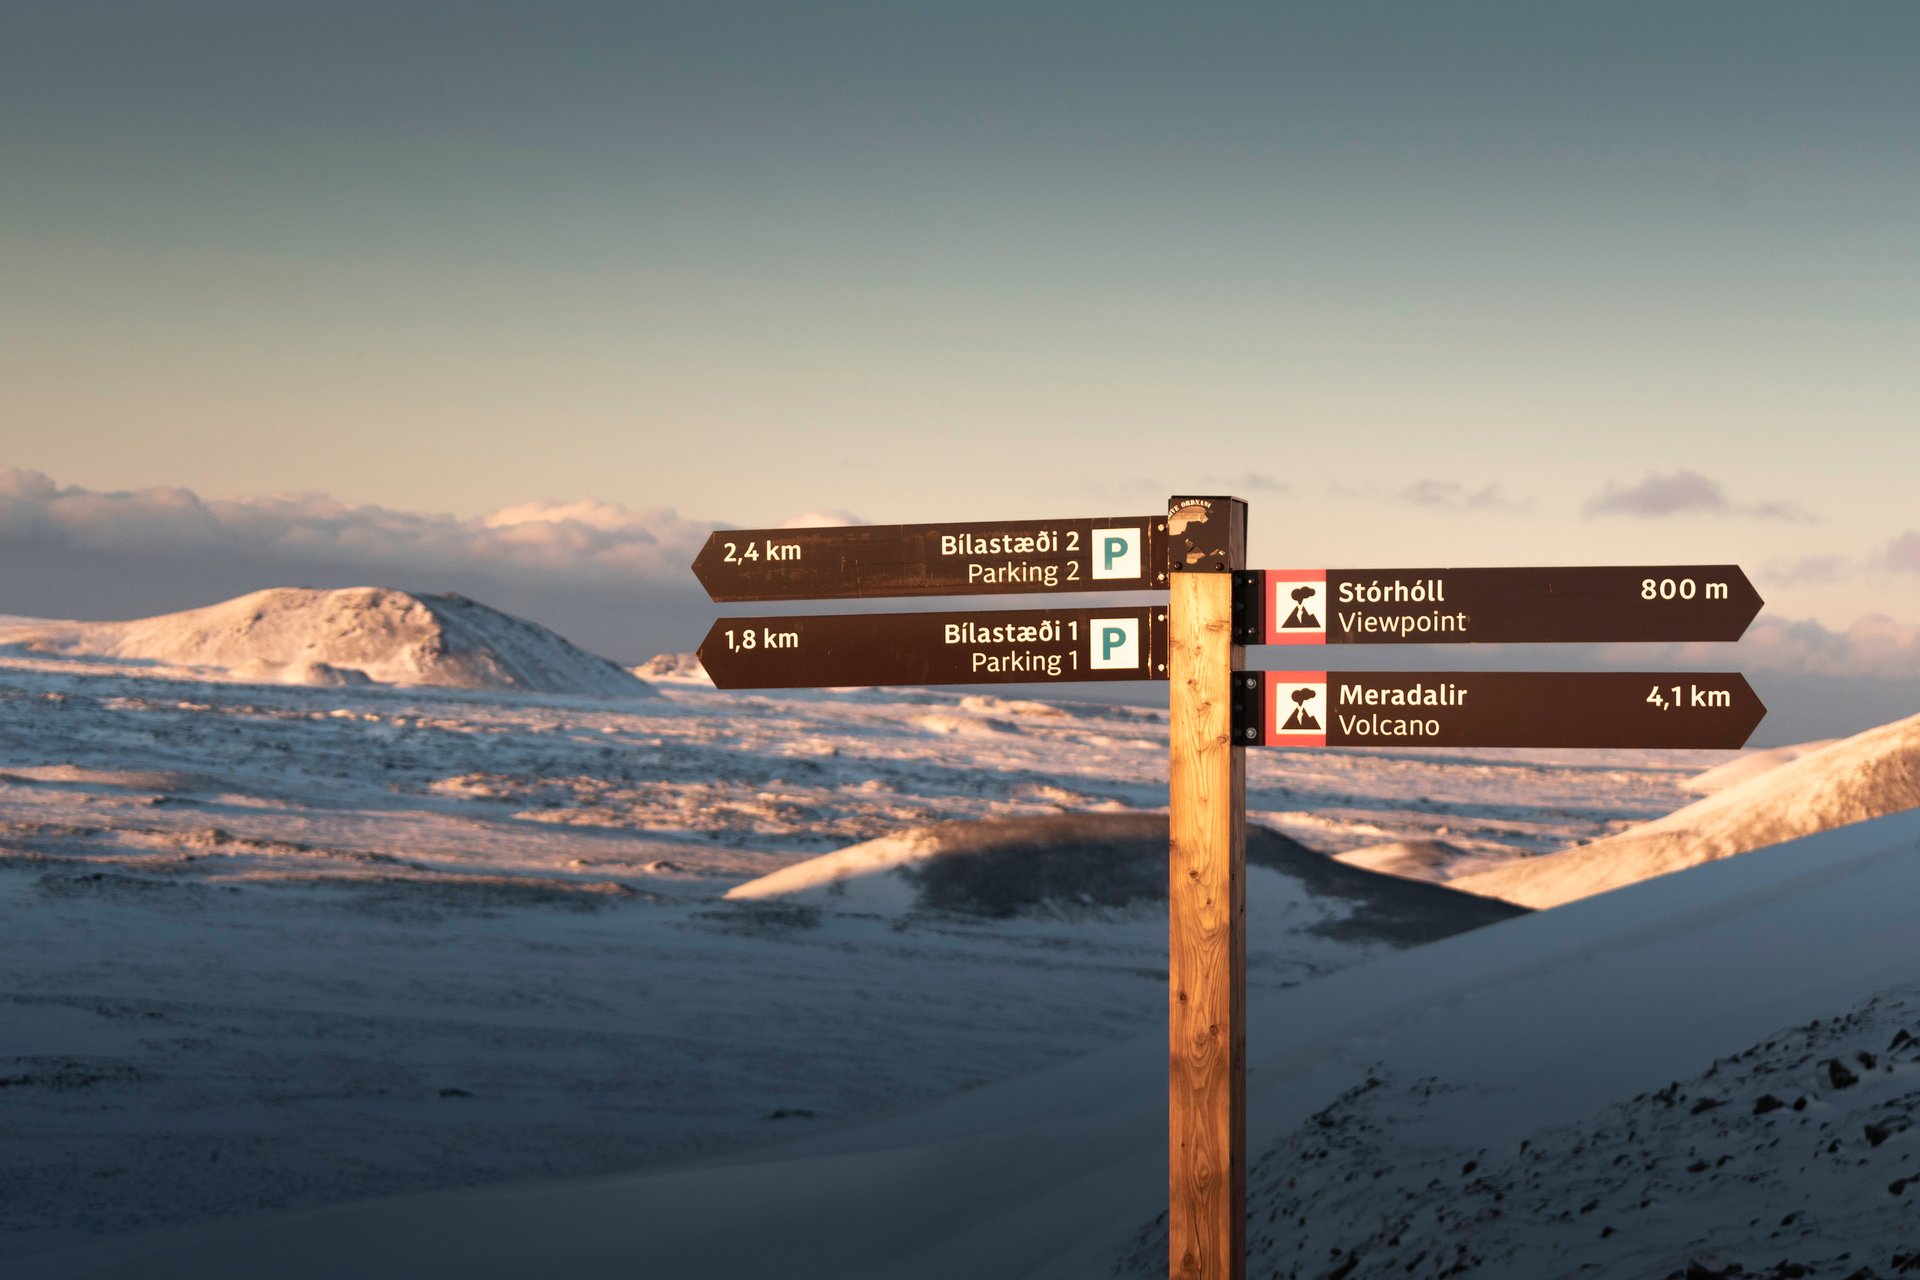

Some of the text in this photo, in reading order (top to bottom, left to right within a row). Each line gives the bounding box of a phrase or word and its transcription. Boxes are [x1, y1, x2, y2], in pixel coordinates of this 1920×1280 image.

[723, 539, 802, 566] 2,4 km
[941, 530, 1080, 556] Bílastæði 2
[1104, 537, 1129, 570] P
[968, 560, 1080, 587] Parking 2
[1338, 579, 1445, 603] Stórhóll
[1640, 578, 1728, 600] 800 m
[944, 619, 1078, 644] Bílastæði 1
[1337, 610, 1467, 638] Viewpoint
[724, 627, 799, 654] 1,8 km
[1102, 627, 1127, 661] P
[972, 650, 1078, 676] Parking 1
[1339, 683, 1468, 706] Meradalir
[1645, 684, 1731, 711] 4,1 km
[1338, 713, 1440, 736] Volcano
